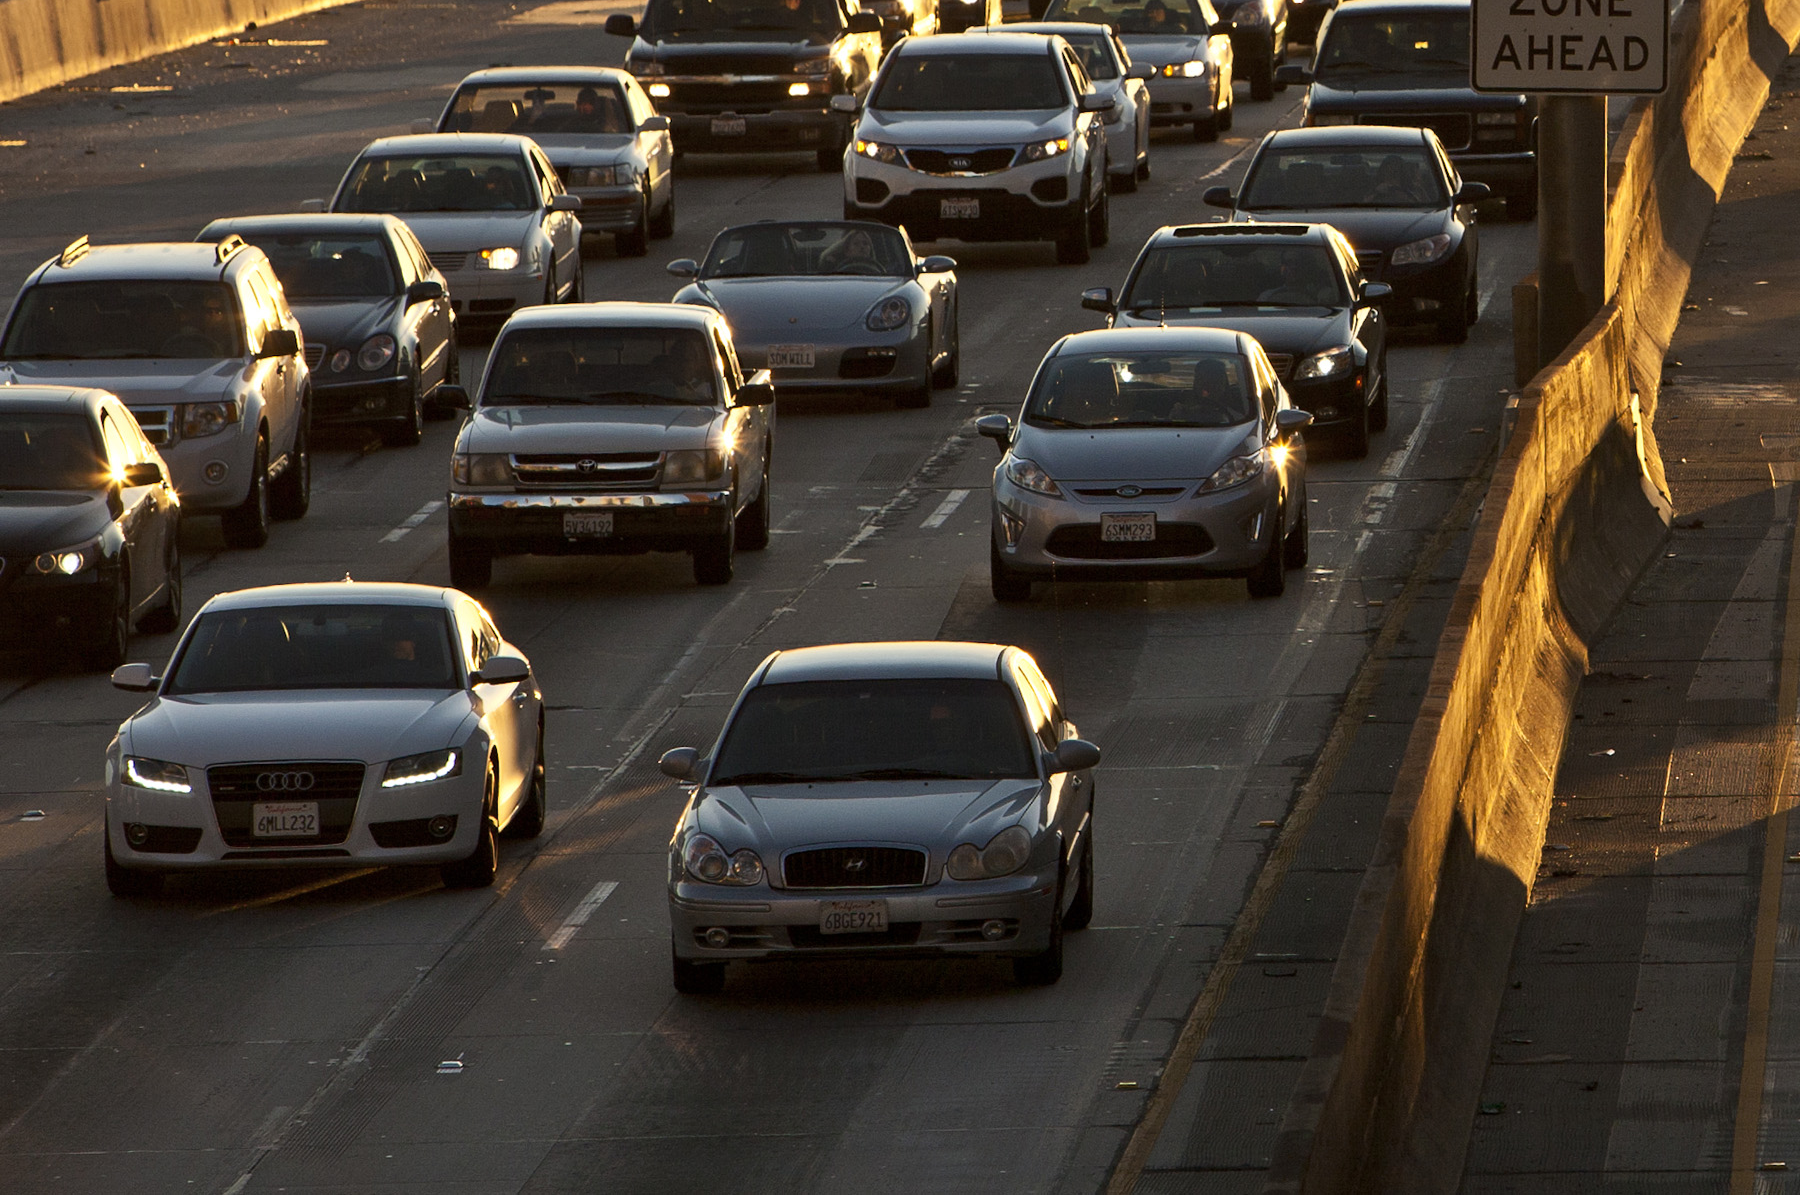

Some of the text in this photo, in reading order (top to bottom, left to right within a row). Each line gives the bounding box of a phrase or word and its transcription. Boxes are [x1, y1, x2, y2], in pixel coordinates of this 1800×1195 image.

[1491, 34, 1649, 72] AHEAD
[1105, 524, 1153, 536] 6SMM293
[267, 805, 304, 815] California
[258, 814, 315, 832] 6MLL232
[831, 901, 876, 912] California
[824, 912, 884, 930] 6BGE921
